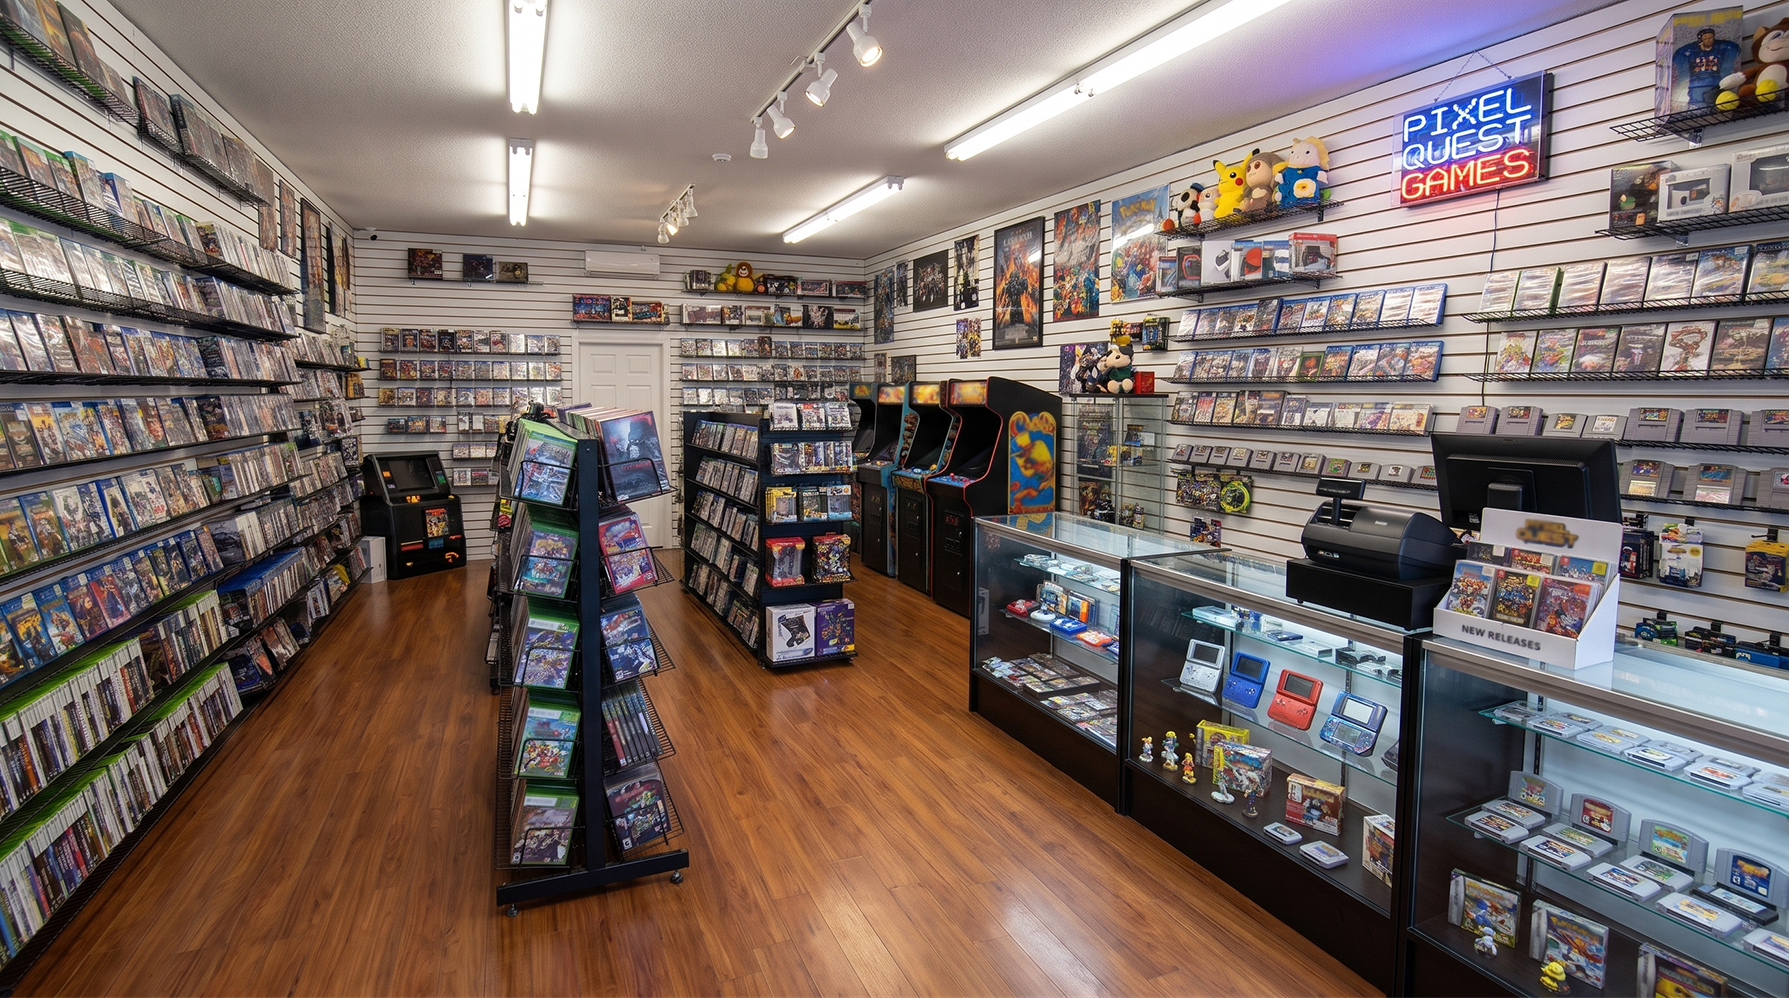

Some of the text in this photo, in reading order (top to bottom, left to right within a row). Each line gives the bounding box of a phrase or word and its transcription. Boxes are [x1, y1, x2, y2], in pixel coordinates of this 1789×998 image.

[1403, 87, 1532, 143] PIXEL
[1402, 114, 1532, 171] QUEST
[1401, 148, 1531, 200] GAMES
[1461, 624, 1541, 651] NEW RELEASES
